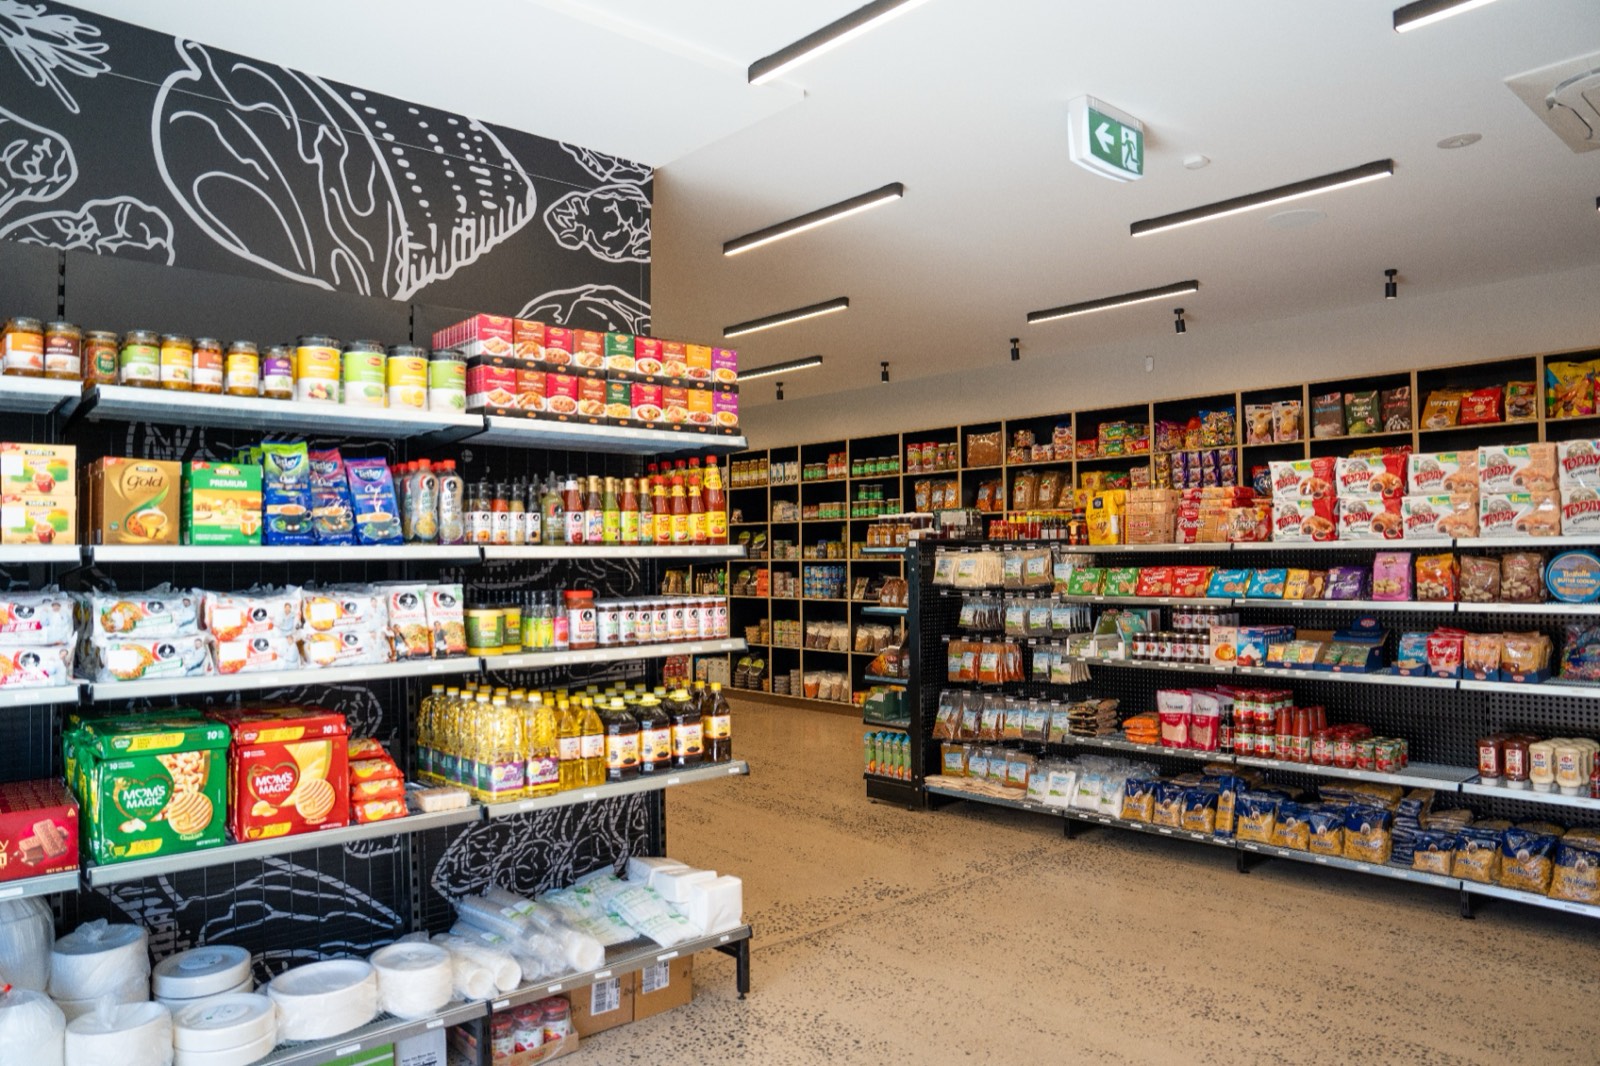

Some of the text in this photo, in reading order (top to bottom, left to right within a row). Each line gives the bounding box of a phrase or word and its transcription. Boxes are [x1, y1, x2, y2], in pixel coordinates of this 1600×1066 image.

[1341, 471, 1374, 486] TODAY
[1413, 470, 1446, 485] TODAY
[1479, 464, 1517, 480] TODAY
[209, 478, 248, 488] PREMIUM
[1275, 476, 1301, 490] TODAY
[1276, 514, 1304, 529] TODAY
[1343, 512, 1374, 527] TODAY
[1405, 513, 1440, 528] TODAY
[1482, 510, 1518, 526] TODAY
[206, 731, 218, 740] 10
[323, 725, 333, 734] 10
[259, 782, 291, 794] MAGIC
[126, 796, 163, 809] MAGIC
